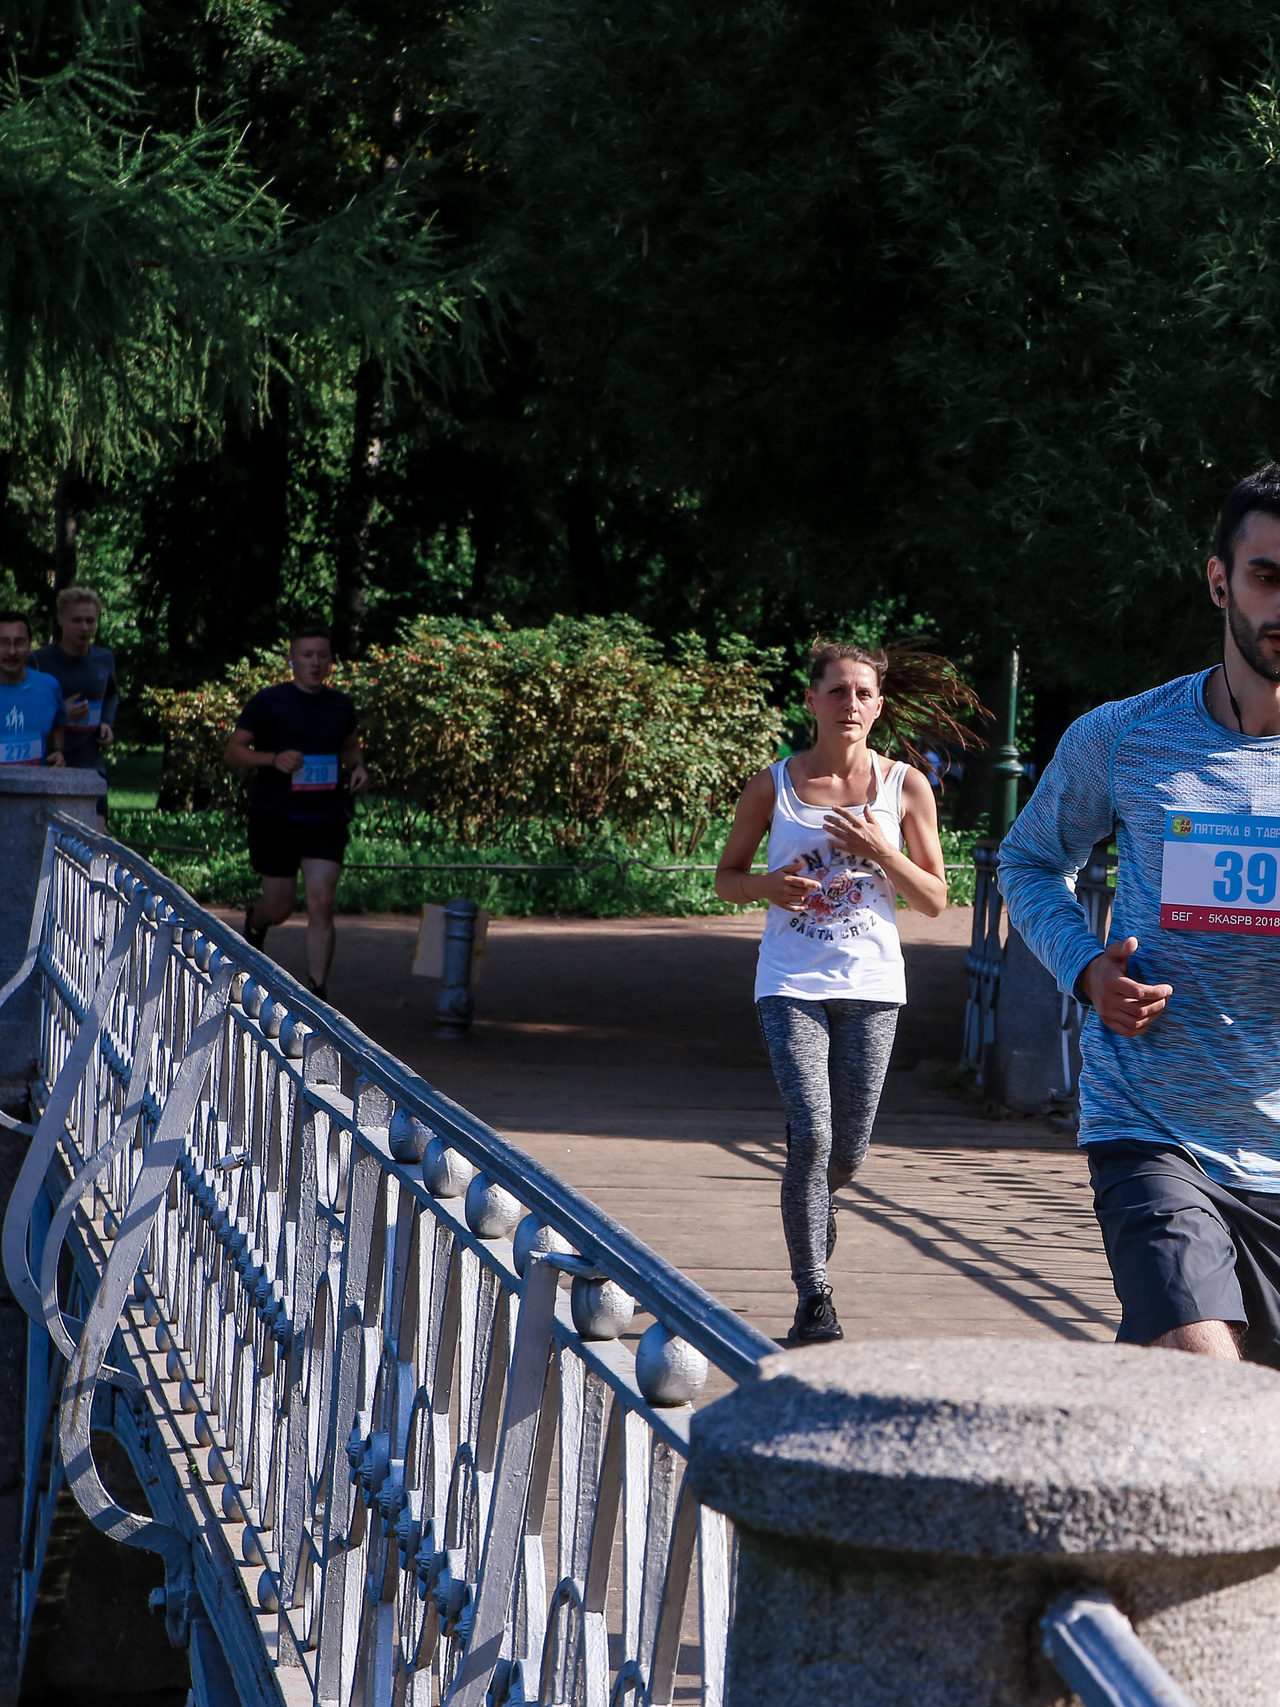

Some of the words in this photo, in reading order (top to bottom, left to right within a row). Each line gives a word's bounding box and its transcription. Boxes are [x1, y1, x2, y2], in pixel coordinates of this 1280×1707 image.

[5, 743, 31, 761] 272
[1194, 823, 1240, 836] ПЯТЕРКА
[1244, 828, 1251, 837] В
[1213, 850, 1278, 904] 39
[1171, 911, 1193, 922] БЕГ
[1208, 914, 1252, 926] 5KASPB
[1255, 916, 1280, 927] 2018
